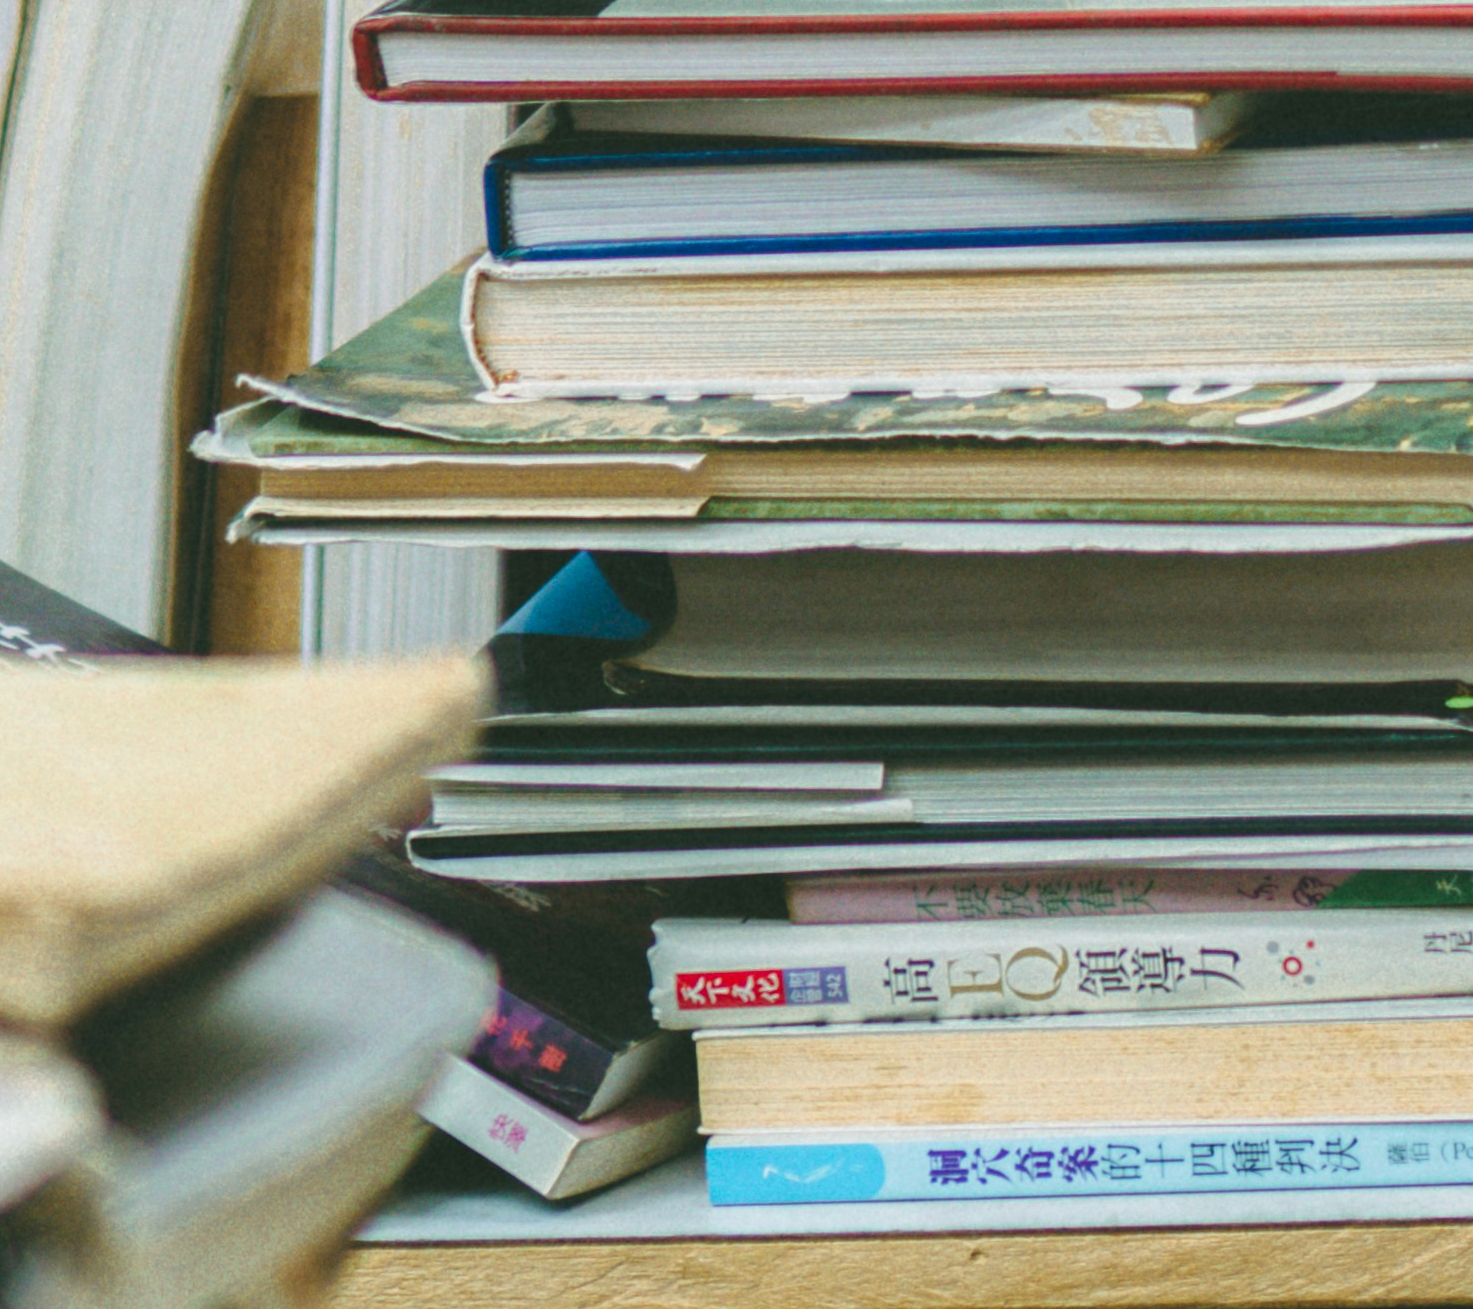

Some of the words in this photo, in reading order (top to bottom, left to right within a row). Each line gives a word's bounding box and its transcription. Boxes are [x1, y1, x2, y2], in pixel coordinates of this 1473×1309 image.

[916, 880, 1158, 920] 不要放棄春天
[680, 972, 781, 1005] 天下文化
[825, 973, 844, 999] 542
[883, 943, 1247, 1004] 高EQ領導力
[927, 1136, 1361, 1186] 洞穴奇案的十四種判決
